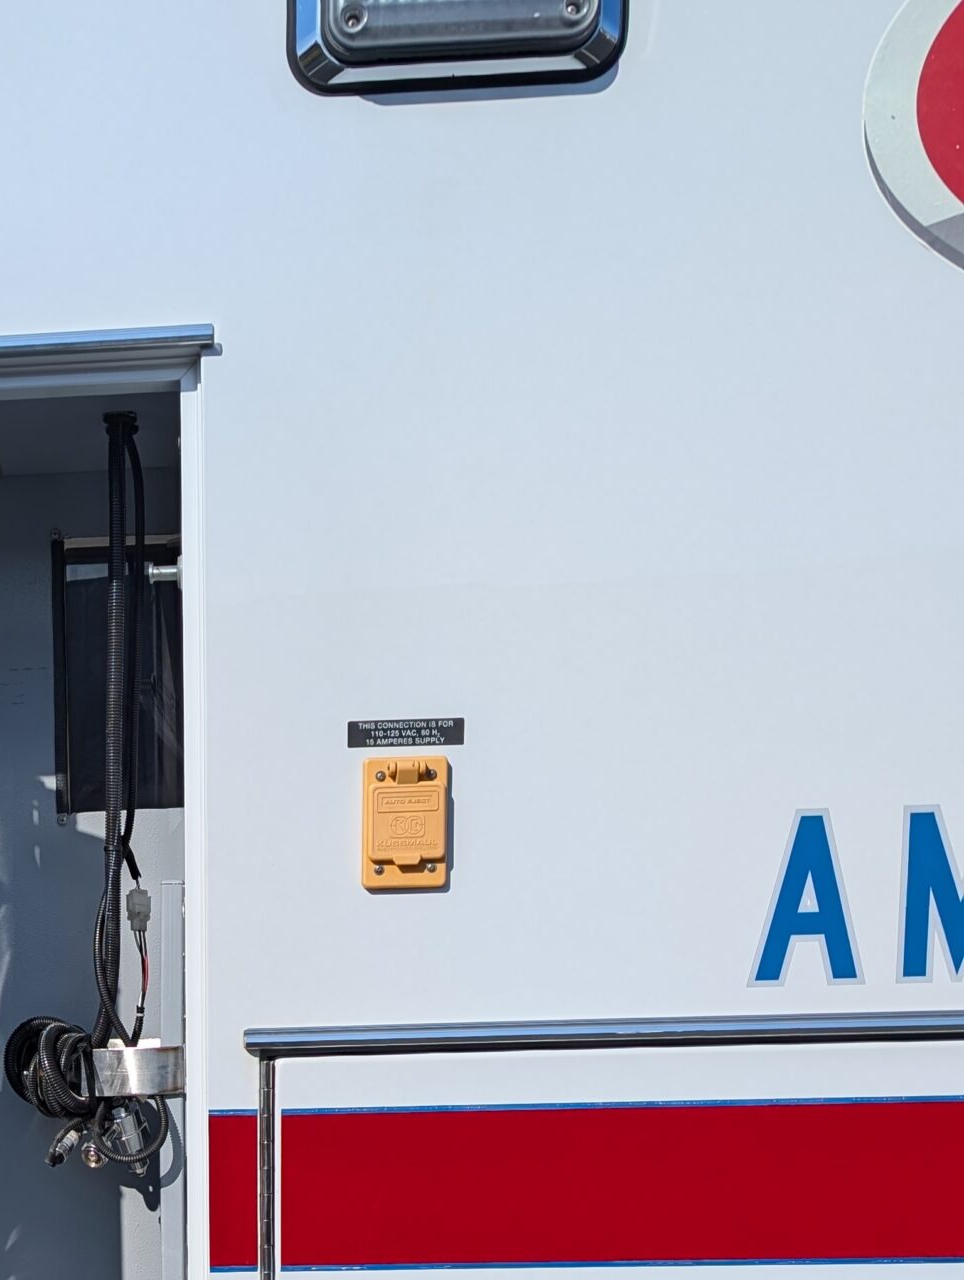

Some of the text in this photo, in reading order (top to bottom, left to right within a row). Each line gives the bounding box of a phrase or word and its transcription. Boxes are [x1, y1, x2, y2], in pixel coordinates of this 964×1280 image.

[358, 722, 375, 730] THIS
[377, 721, 427, 729] CONNECTION
[429, 720, 436, 728] IS
